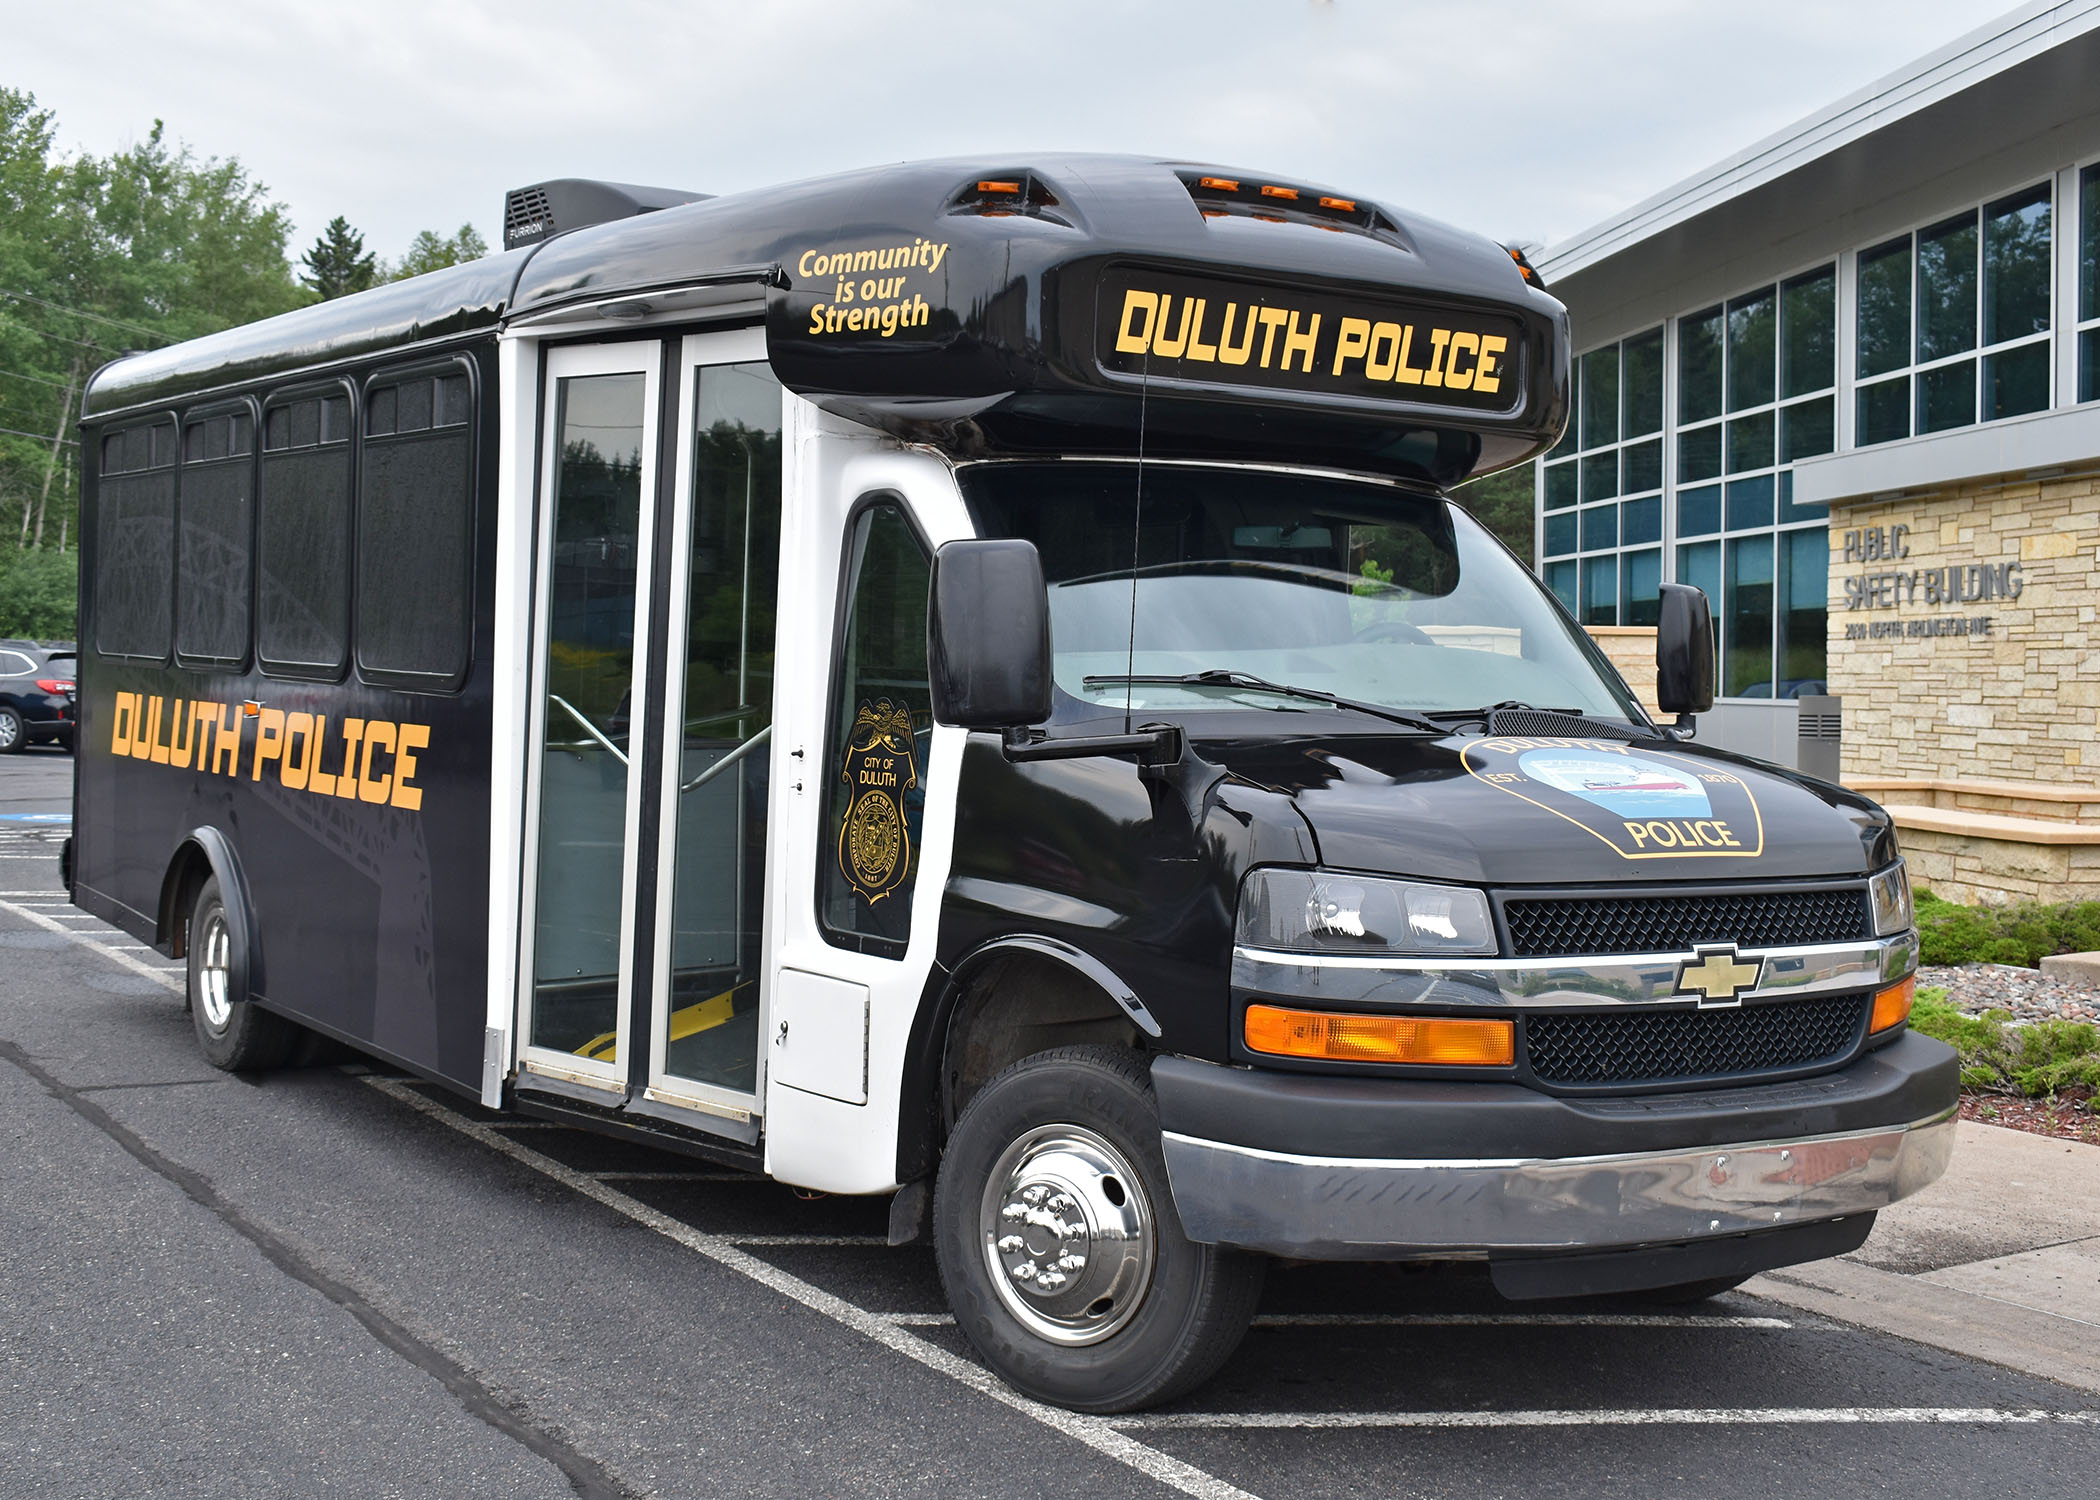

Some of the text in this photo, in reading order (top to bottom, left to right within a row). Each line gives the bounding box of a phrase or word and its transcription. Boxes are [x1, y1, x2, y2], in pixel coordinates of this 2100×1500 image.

[509, 222, 543, 240] FURRION
[798, 237, 949, 278] Community
[834, 275, 906, 303] is our
[808, 294, 930, 338] Strength
[1115, 289, 1508, 393] DULUTH POLICE
[1844, 523, 1910, 563] PUBLIC
[1844, 561, 2023, 610] SAFETY BUILDING
[1869, 621, 1905, 639] NORTH
[1907, 618, 1966, 637] ARLINGTON
[111, 691, 431, 811] DULUTH POLICE
[1482, 737, 1629, 755] DULUTH
[864, 756, 895, 770] CITY OF
[859, 770, 897, 787] DULUTH
[1484, 773, 1528, 783] EST.
[1697, 774, 1738, 784] 1870
[858, 797, 872, 815] SEAL
[871, 795, 879, 803] OF
[878, 796, 889, 809] THE
[887, 807, 897, 825] CITY
[892, 828, 898, 838] OF
[1623, 821, 1742, 848] POLICE
